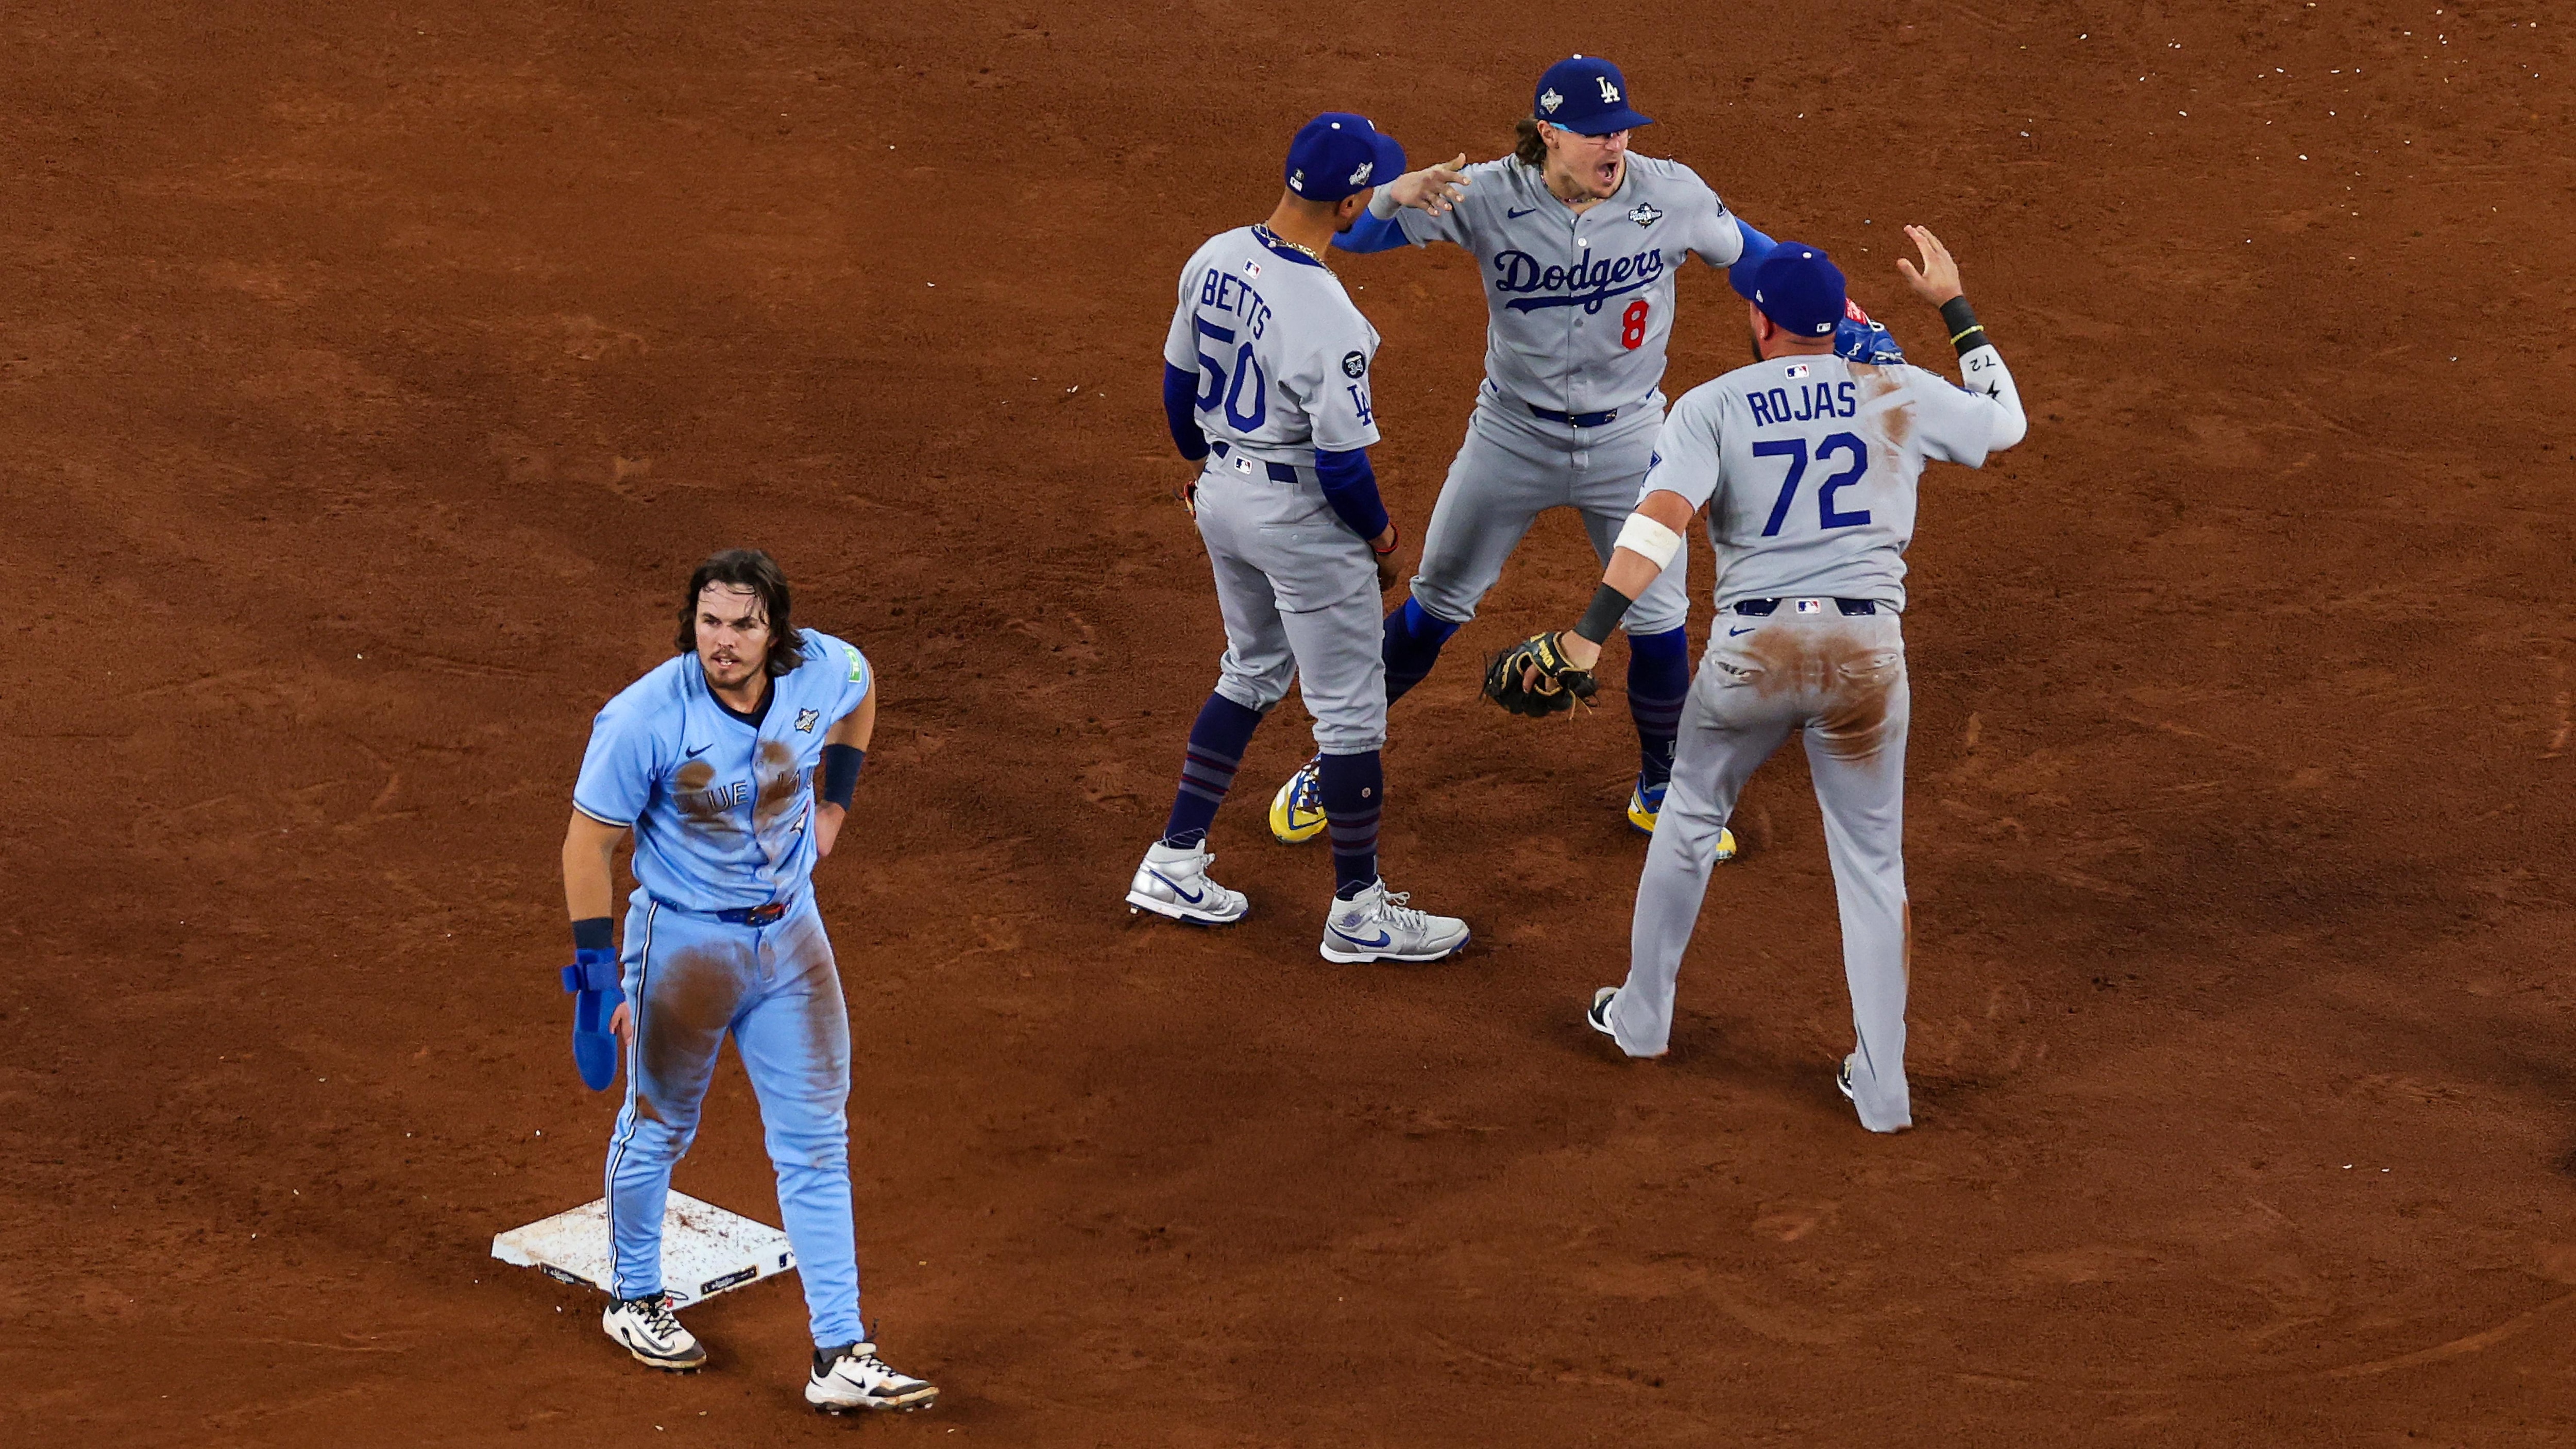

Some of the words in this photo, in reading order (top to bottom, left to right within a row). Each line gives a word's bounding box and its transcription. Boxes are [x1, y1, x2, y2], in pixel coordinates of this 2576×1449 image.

[1596, 76, 1620, 104] LA
[1201, 268, 1272, 341] BETTS
[1494, 248, 1664, 314] Dodgers
[1621, 300, 1649, 351] 8
[1195, 313, 1266, 433] 50
[1347, 359, 1363, 376] 34
[1969, 354, 1997, 371] 72
[1347, 384, 1371, 427] LA
[1747, 381, 1856, 428] ROJAS
[1753, 431, 1871, 537] 72
